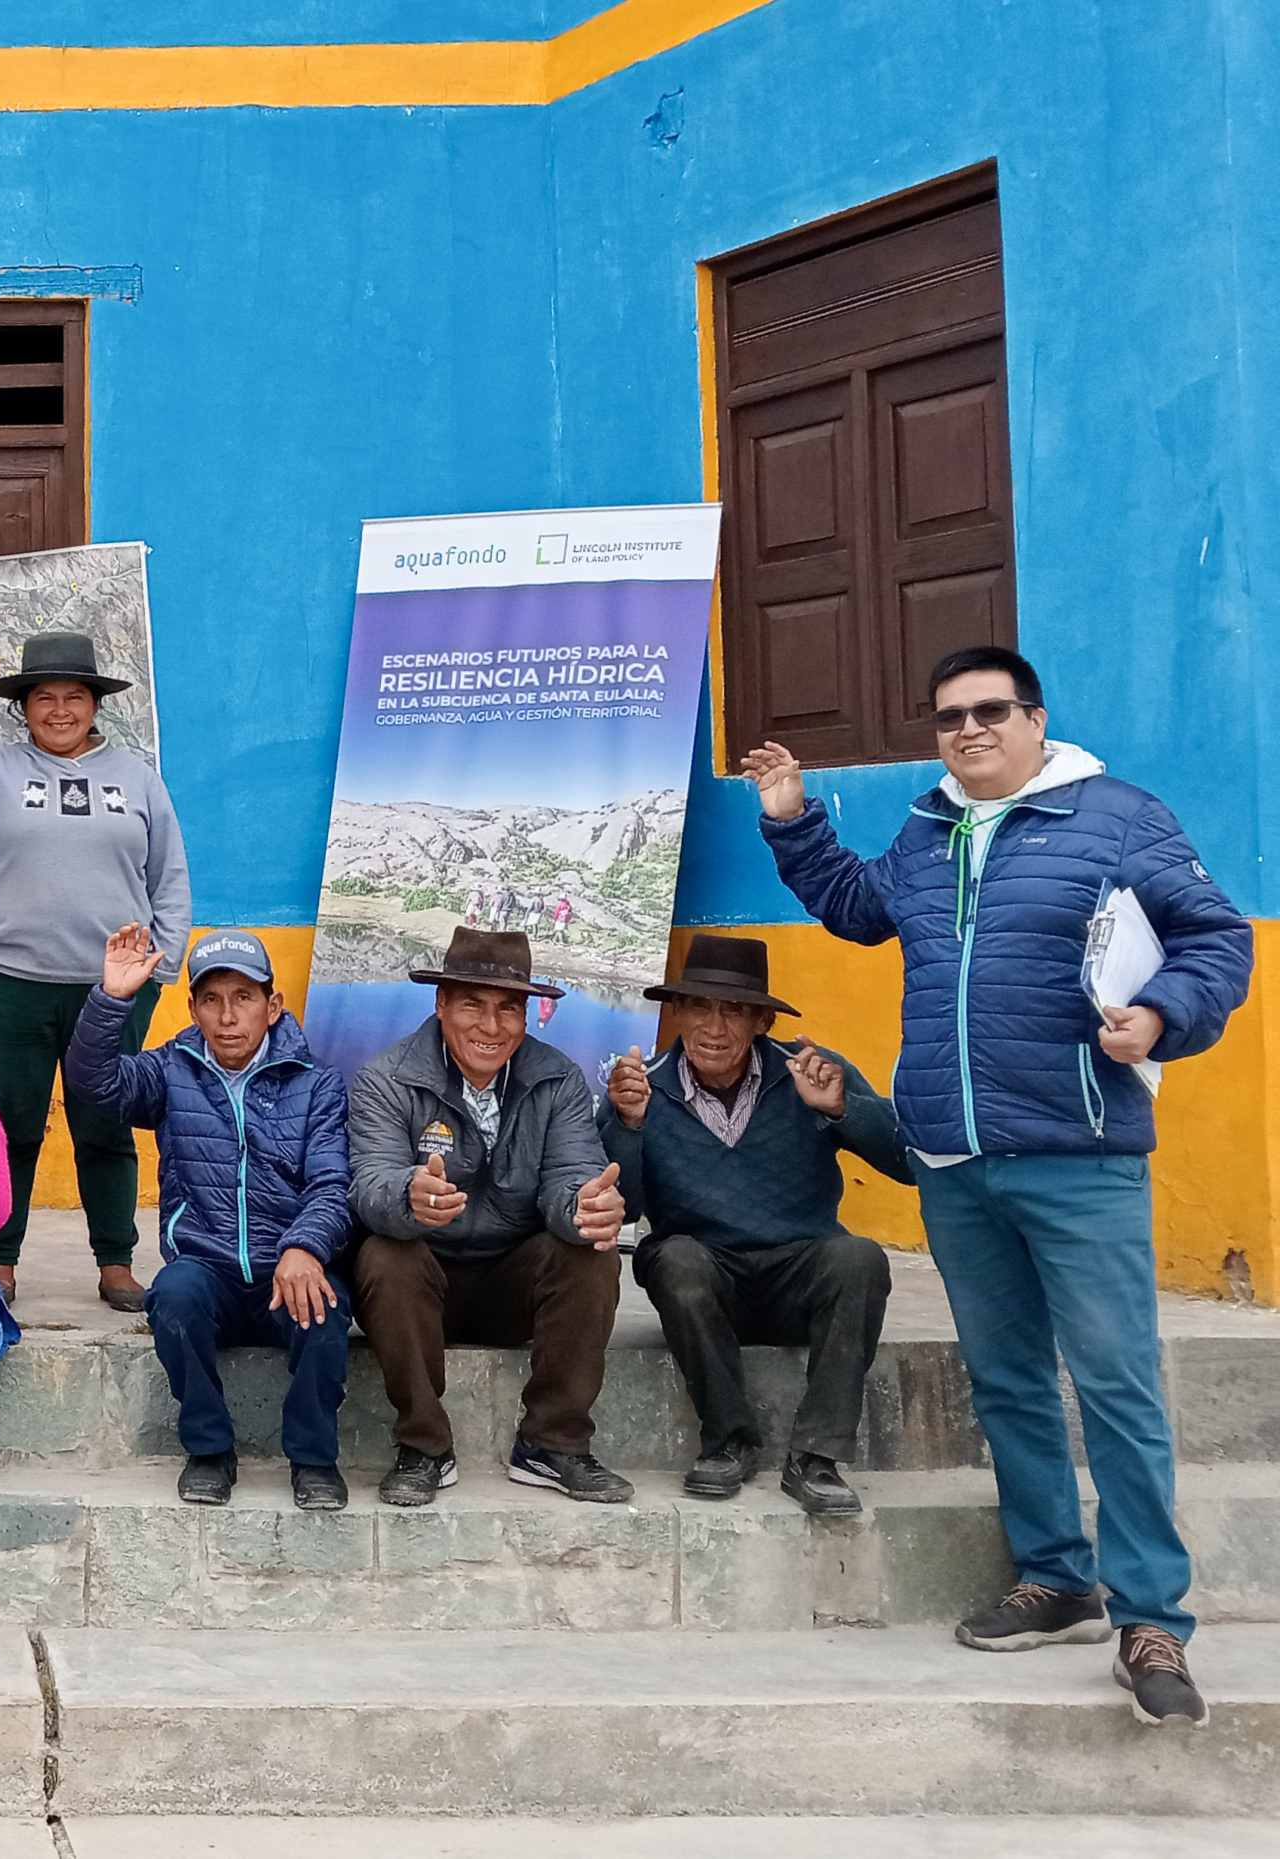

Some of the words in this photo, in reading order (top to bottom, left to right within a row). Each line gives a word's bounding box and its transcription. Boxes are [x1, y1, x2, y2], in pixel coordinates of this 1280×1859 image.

[573, 542, 621, 553] LINCOLN
[624, 541, 682, 551] INSTITUTE
[394, 544, 506, 575] aquafondo
[612, 554, 643, 562] POLICY
[382, 651, 493, 669] ESCENARIOS
[497, 646, 582, 664] FUTUROS
[587, 644, 638, 660] PARA
[643, 645, 669, 660] LA
[379, 667, 540, 693] RESILIENCIA
[547, 660, 666, 686] HÍDRICA
[377, 698, 398, 709] EN
[400, 697, 419, 709] LA
[421, 693, 512, 708] SUBCUENCA
[515, 692, 537, 704] DE
[539, 690, 590, 703] SANTA
[594, 688, 665, 702] EULALIA:
[376, 712, 466, 725] GOBERNANZA,
[467, 710, 503, 723] AGUA
[505, 710, 515, 720] Y
[516, 706, 572, 720] GESTIÓN
[575, 705, 662, 719] TERRITORIAL
[195, 937, 256, 958] aquafondo
